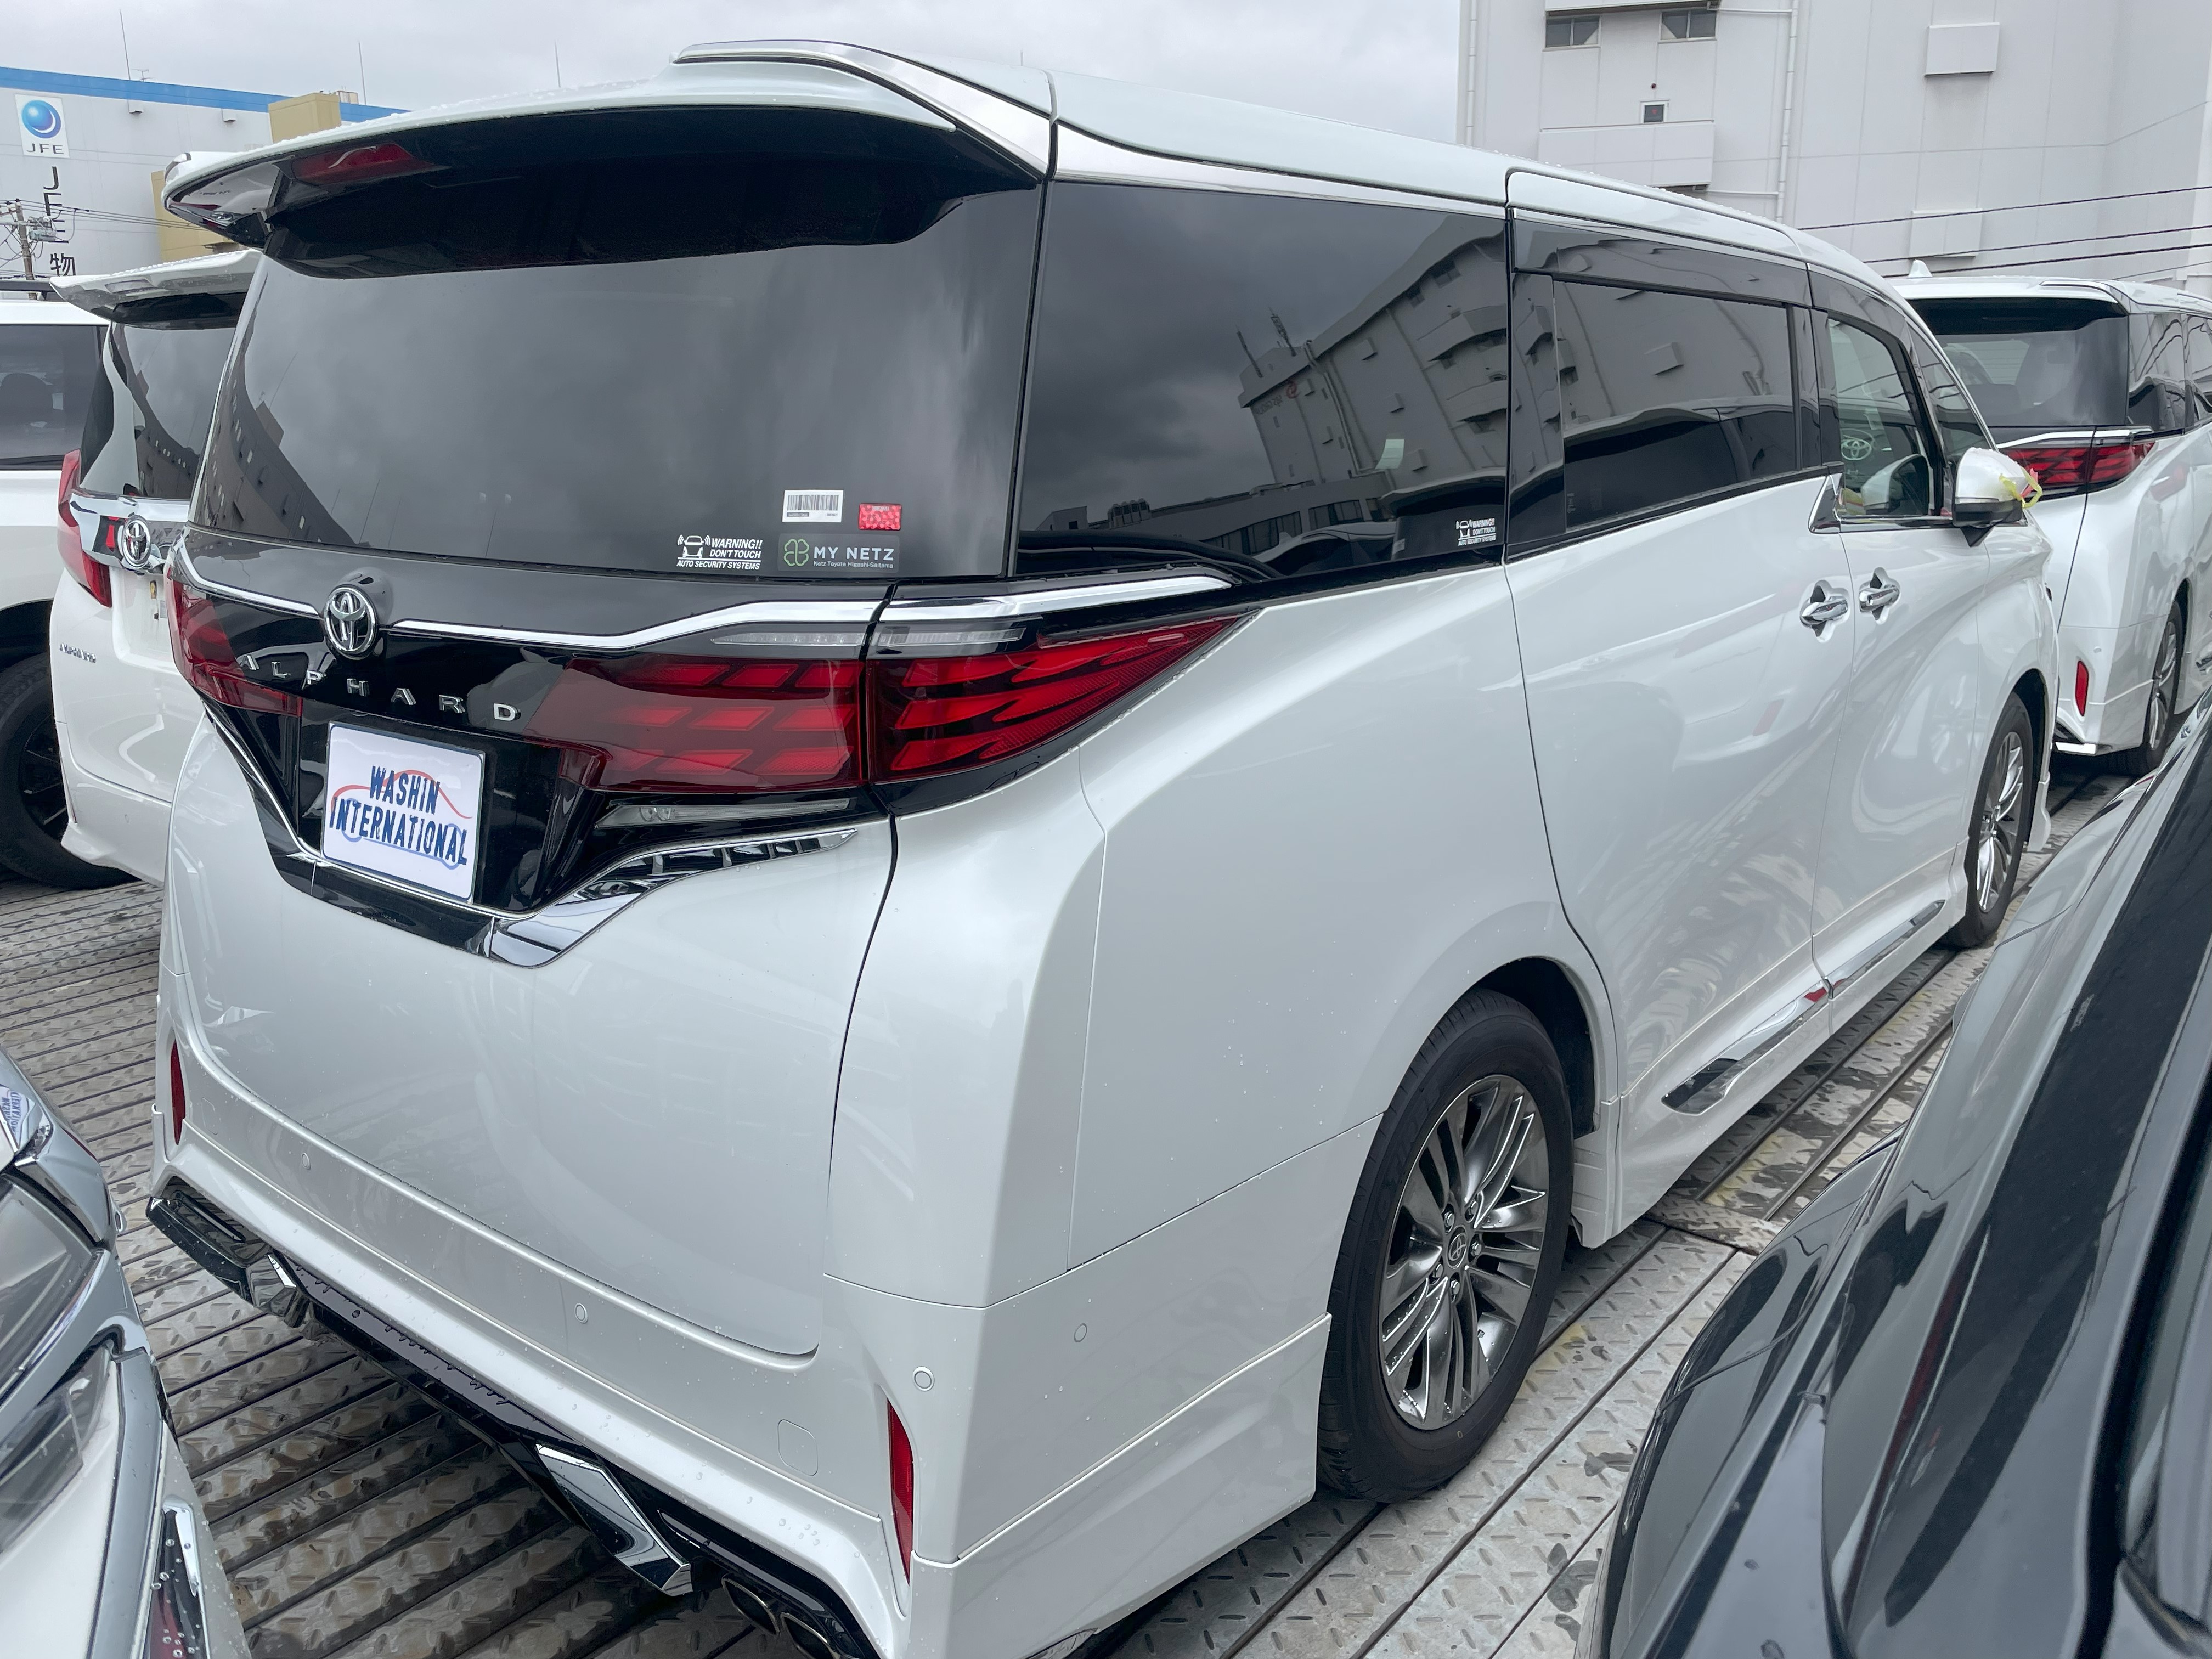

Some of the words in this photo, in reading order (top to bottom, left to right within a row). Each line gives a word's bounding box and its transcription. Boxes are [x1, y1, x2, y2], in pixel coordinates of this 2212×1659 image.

[26, 143, 64, 155] JFE
[712, 538, 763, 549] WARNING!!
[709, 549, 733, 558] DON'T
[734, 550, 761, 559] TOUCH
[814, 546, 839, 560] MY
[846, 547, 894, 561] NETZ
[695, 560, 727, 568] SECURITY
[727, 562, 760, 570] SYSTEMS
[239, 654, 521, 722] ALPHARD
[369, 765, 441, 815] WASHIN
[329, 797, 467, 866] INTERNATIONAL
